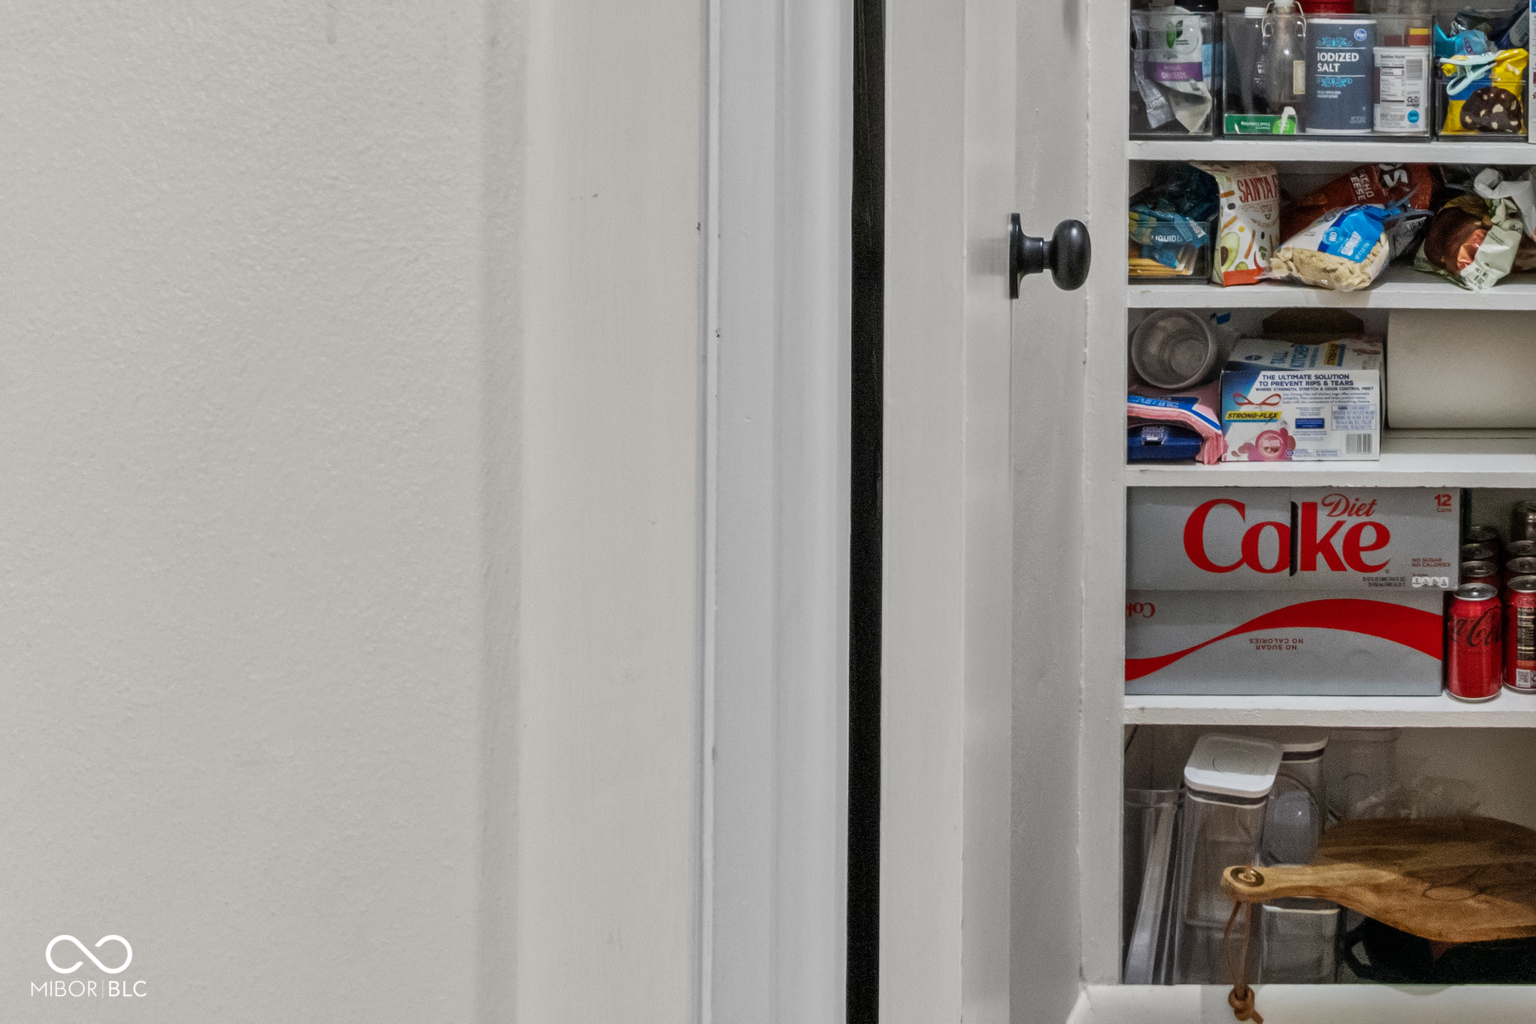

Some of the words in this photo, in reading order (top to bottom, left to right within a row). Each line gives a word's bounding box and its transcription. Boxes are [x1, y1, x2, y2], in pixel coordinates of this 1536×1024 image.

[1317, 52, 1360, 62] IODIZED
[1317, 63, 1340, 72] SALT
[1237, 176, 1271, 203] SANTA
[1227, 411, 1279, 419] STRONG-FLEX
[1321, 493, 1378, 518] Diet
[1434, 494, 1452, 507] 12
[1183, 497, 1391, 574] Coke
[1125, 602, 1156, 618] Cok
